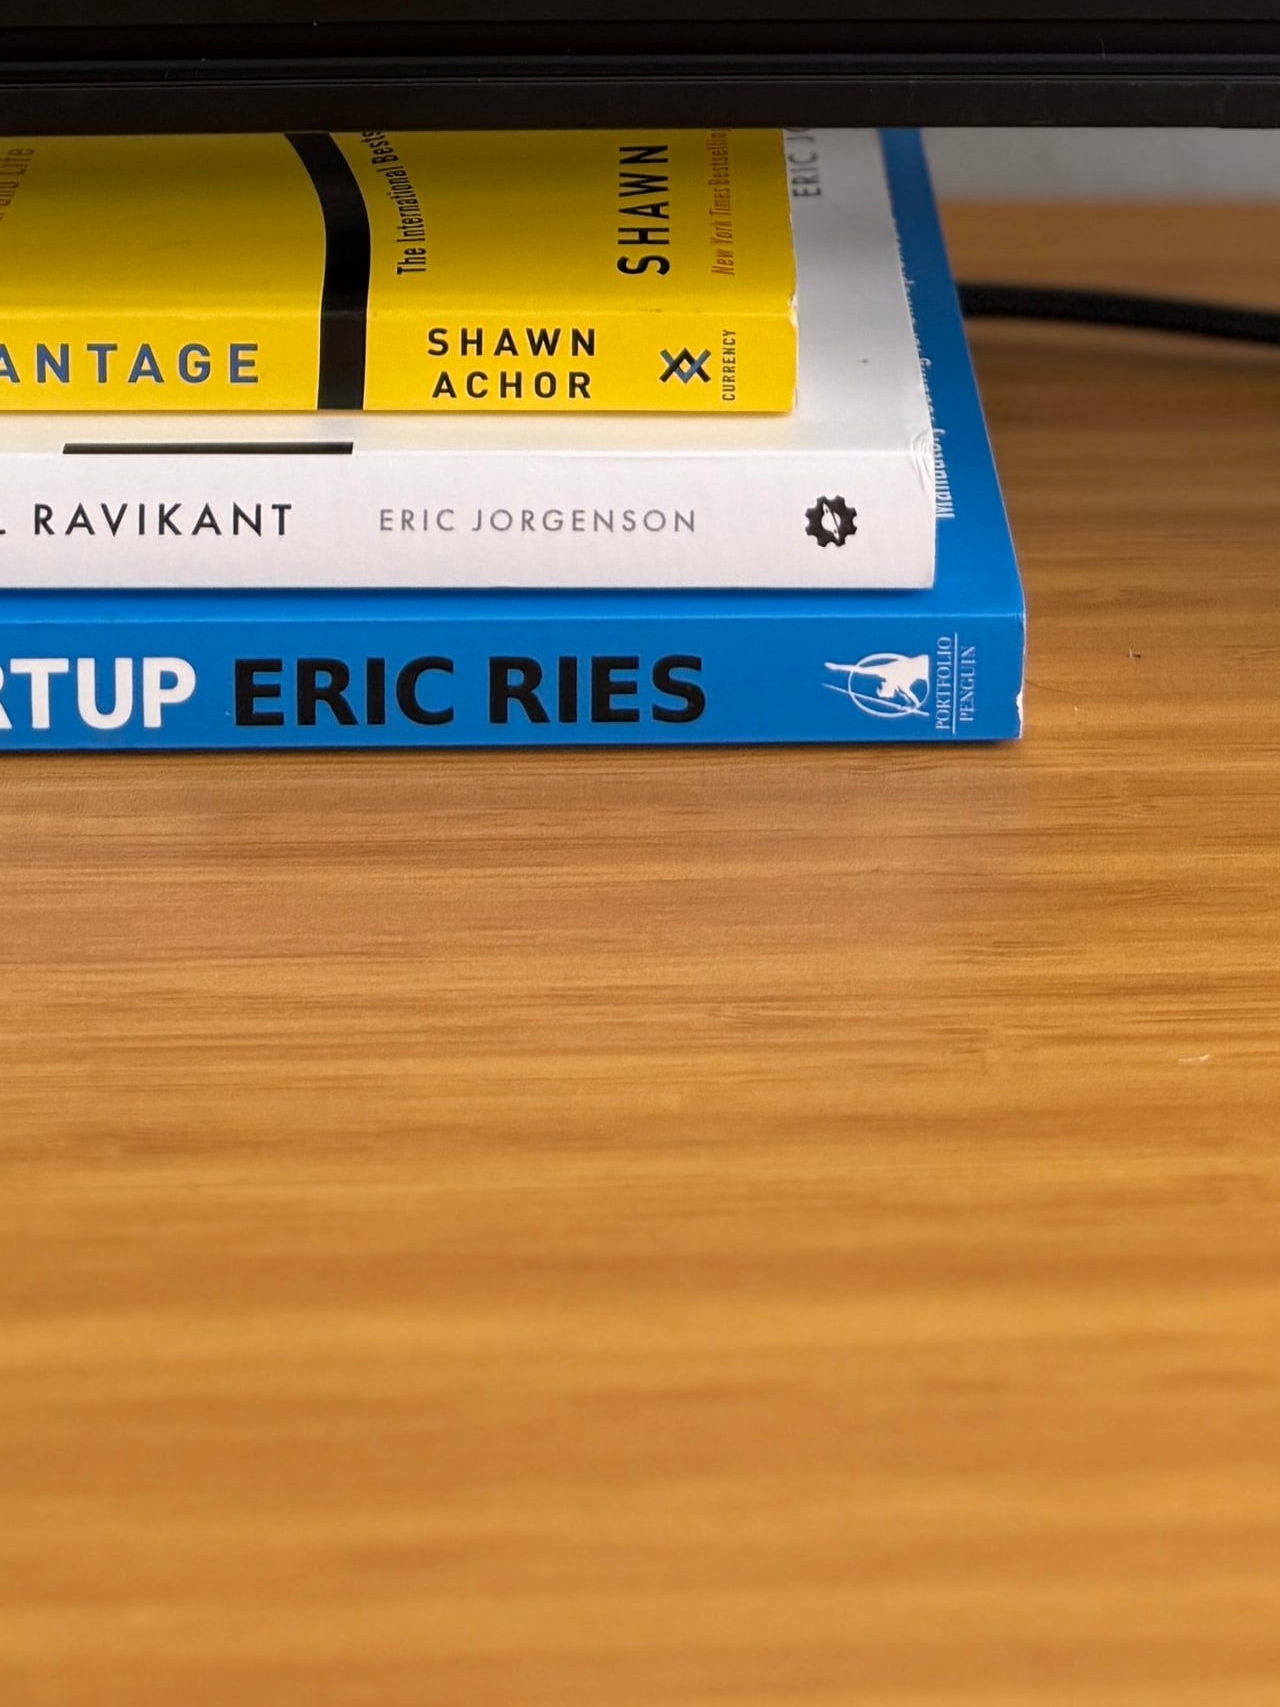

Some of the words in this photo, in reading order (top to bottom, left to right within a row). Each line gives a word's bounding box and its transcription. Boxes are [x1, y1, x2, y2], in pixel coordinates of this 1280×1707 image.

[788, 152, 821, 197] ERIC
[376, 165, 426, 243] International
[617, 145, 670, 275] SHAWN
[709, 188, 731, 215] Times
[710, 220, 733, 245] York
[396, 247, 426, 275] The
[711, 248, 734, 275] New
[428, 328, 595, 356] SHAWN
[722, 329, 736, 402] CURRENCY
[432, 371, 591, 398] ACHOR
[33, 502, 292, 538] RAVIKANT
[380, 508, 455, 532] ERIC
[472, 509, 695, 533] JORGENSON
[235, 657, 454, 727] ERIC
[489, 655, 706, 725] RIES
[935, 636, 952, 730] PORTFOLIO
[959, 646, 976, 722] PENGUIN
